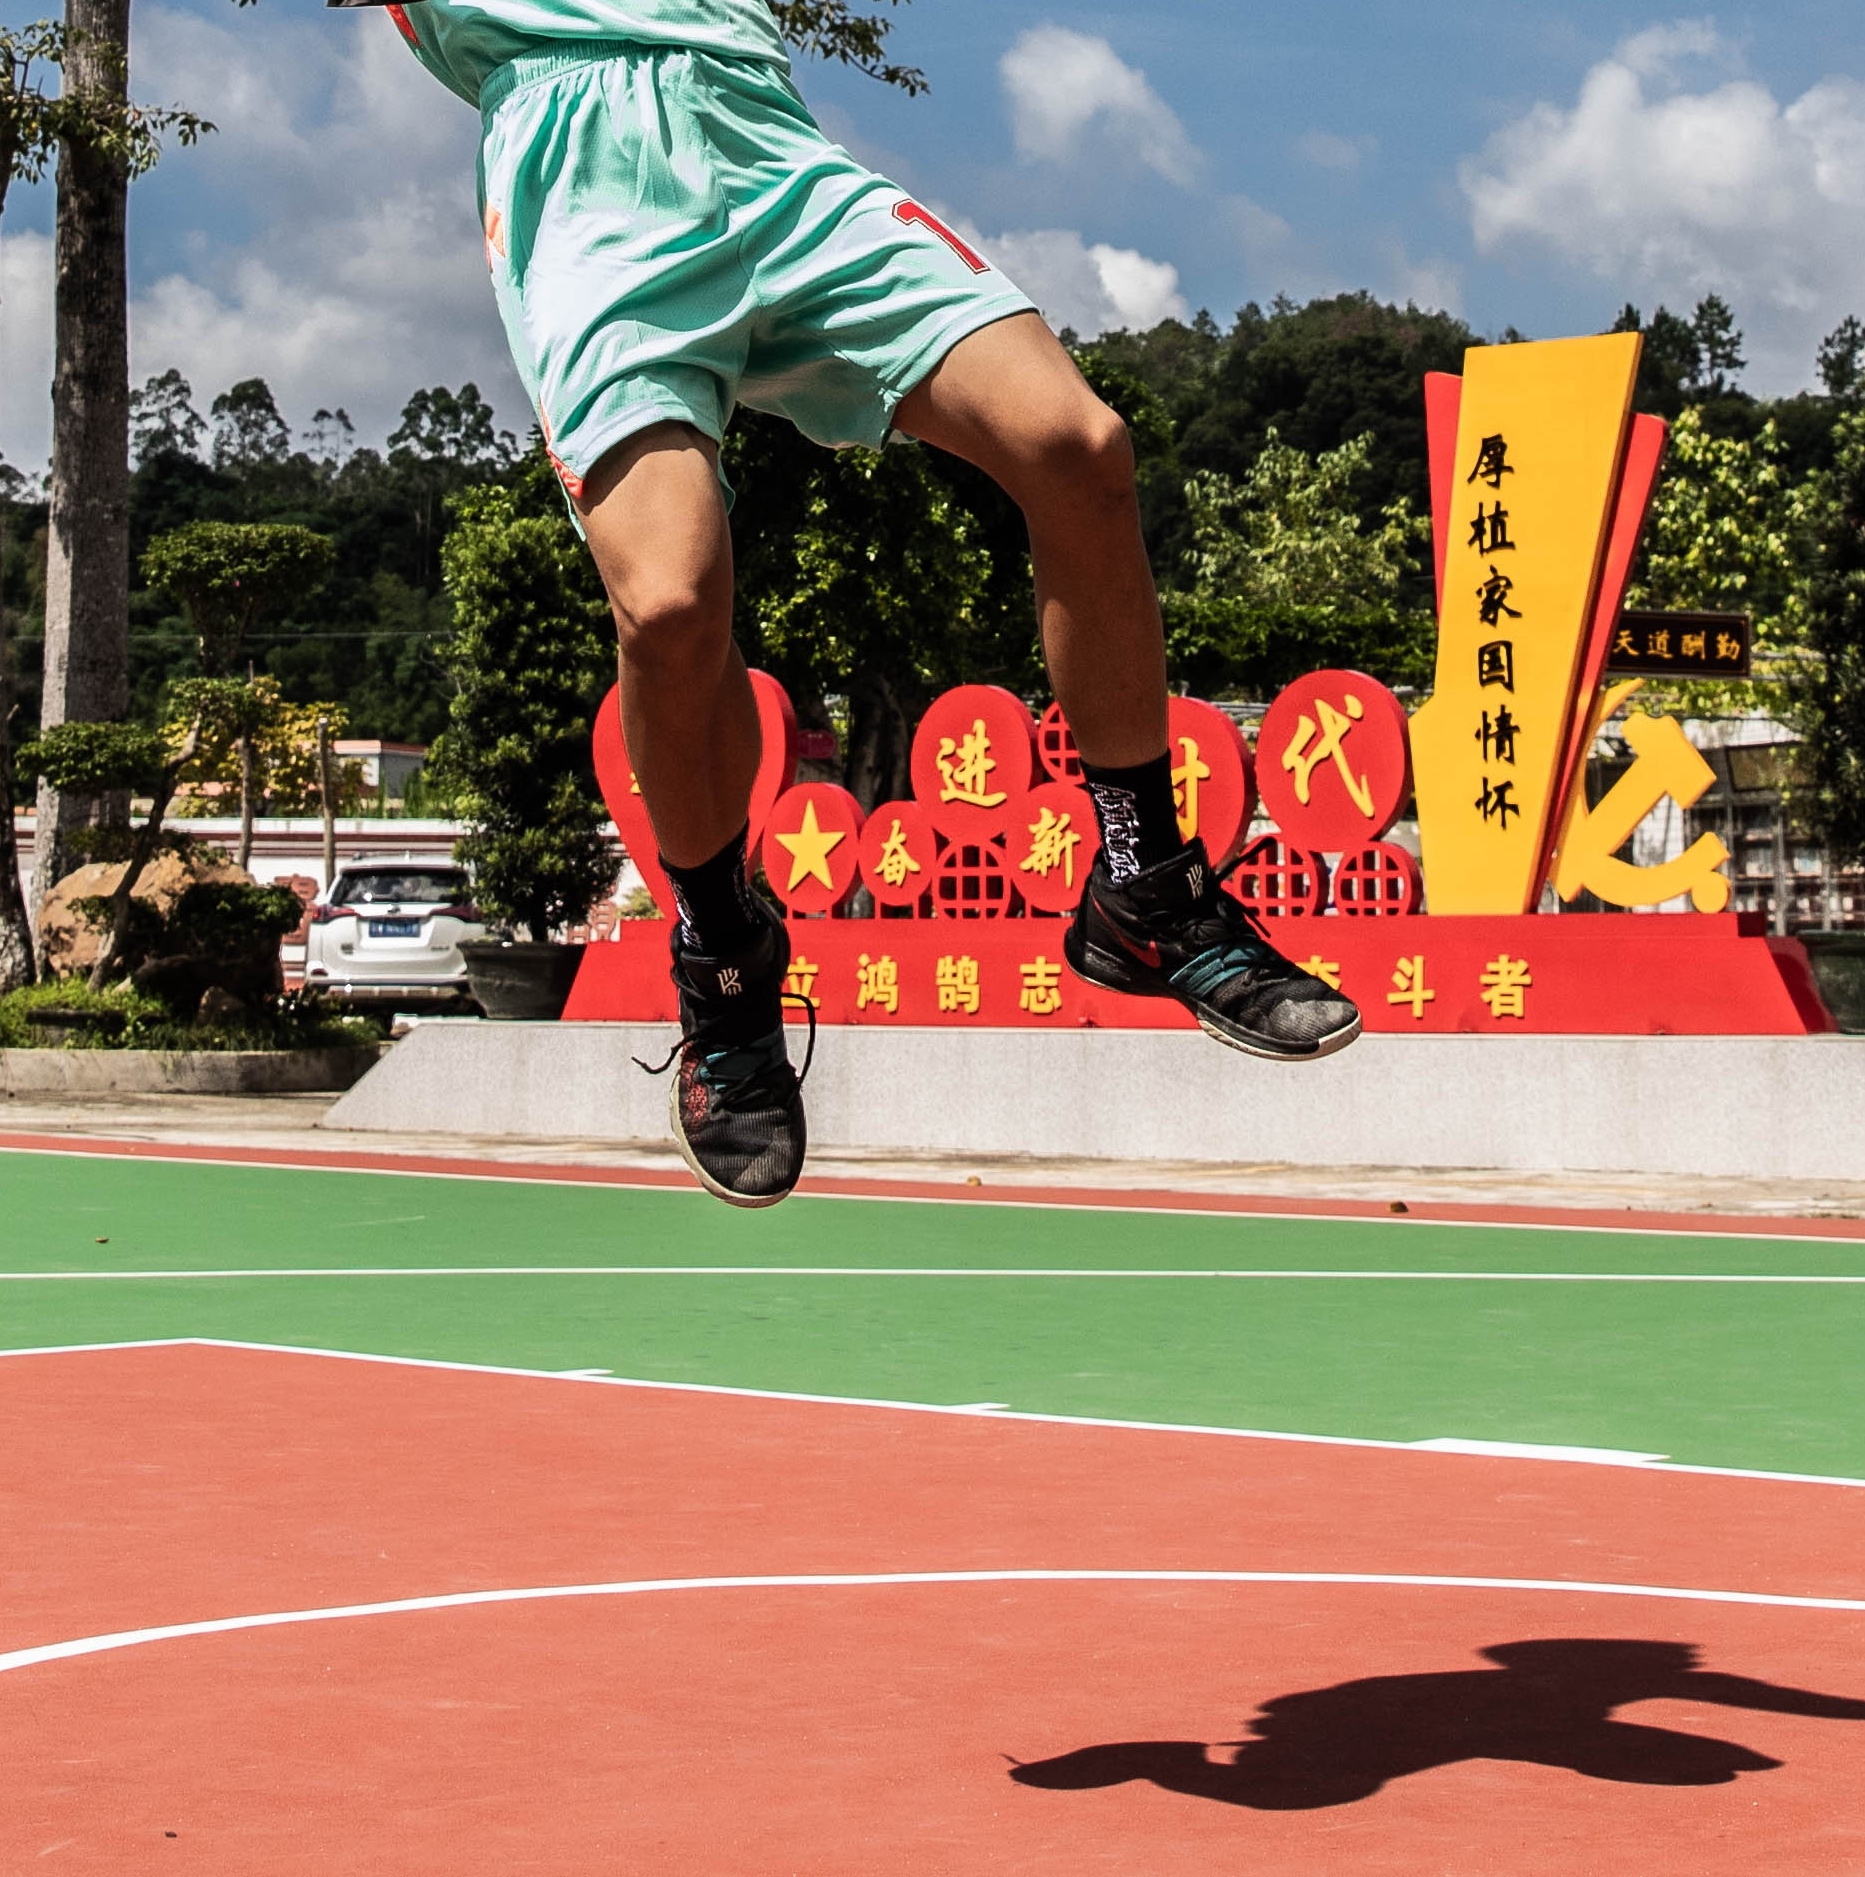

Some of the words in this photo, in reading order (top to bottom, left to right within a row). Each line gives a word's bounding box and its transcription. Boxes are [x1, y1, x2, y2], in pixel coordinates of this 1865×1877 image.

[1466, 433, 1523, 831] 厚植家国情怀
[1612, 628, 1741, 661] 天道酬勤
[780, 953, 1062, 1015] 立鸿鹄志
